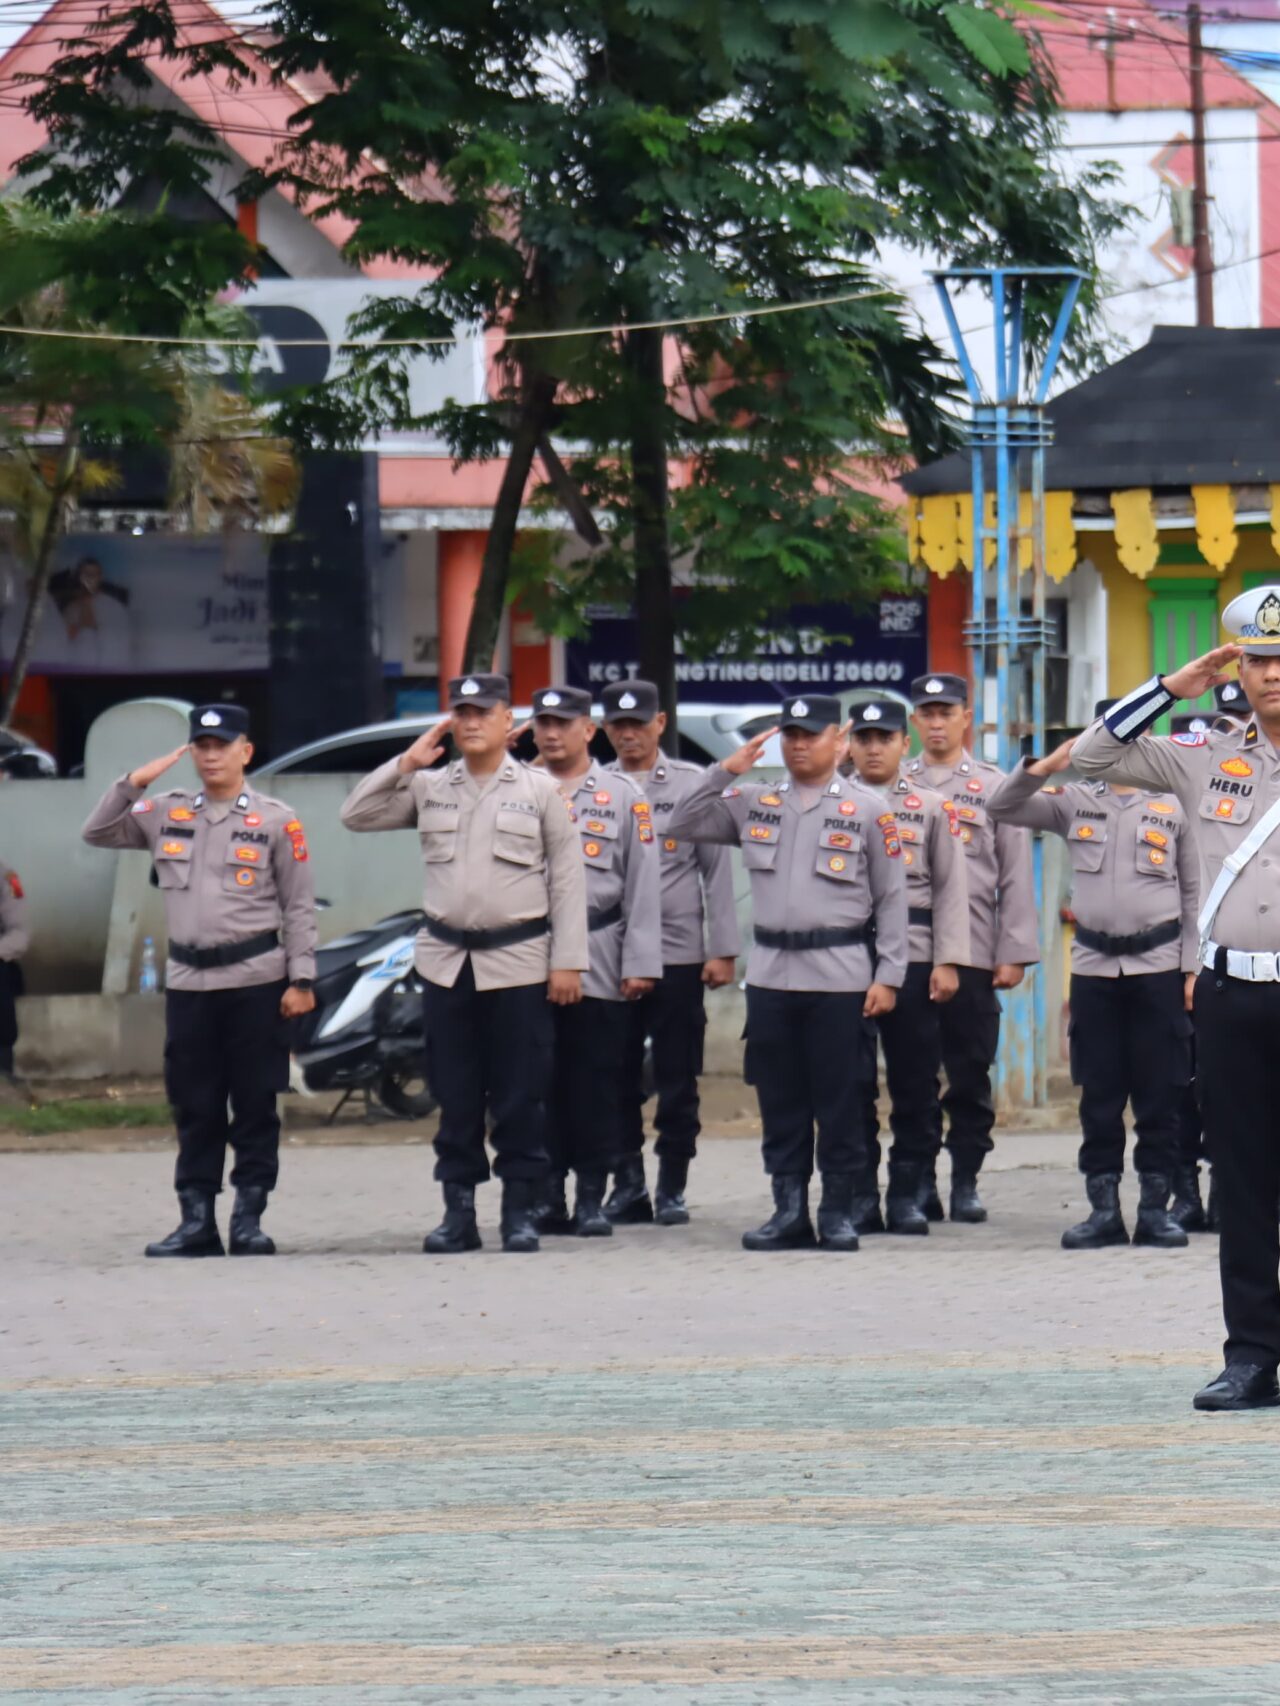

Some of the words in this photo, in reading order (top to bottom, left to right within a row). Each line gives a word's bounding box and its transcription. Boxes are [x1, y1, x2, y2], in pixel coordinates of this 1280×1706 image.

[880, 601, 922, 616] POS
[589, 662, 620, 681] KC
[1209, 777, 1253, 797] HERU
[501, 802, 539, 813] POLRI
[953, 794, 986, 807] POLRI
[581, 808, 615, 819] POLRI
[748, 810, 782, 824] IMAM
[824, 818, 862, 832] POLRI
[1141, 815, 1176, 831] POLRI
[231, 831, 269, 845] POLRI
